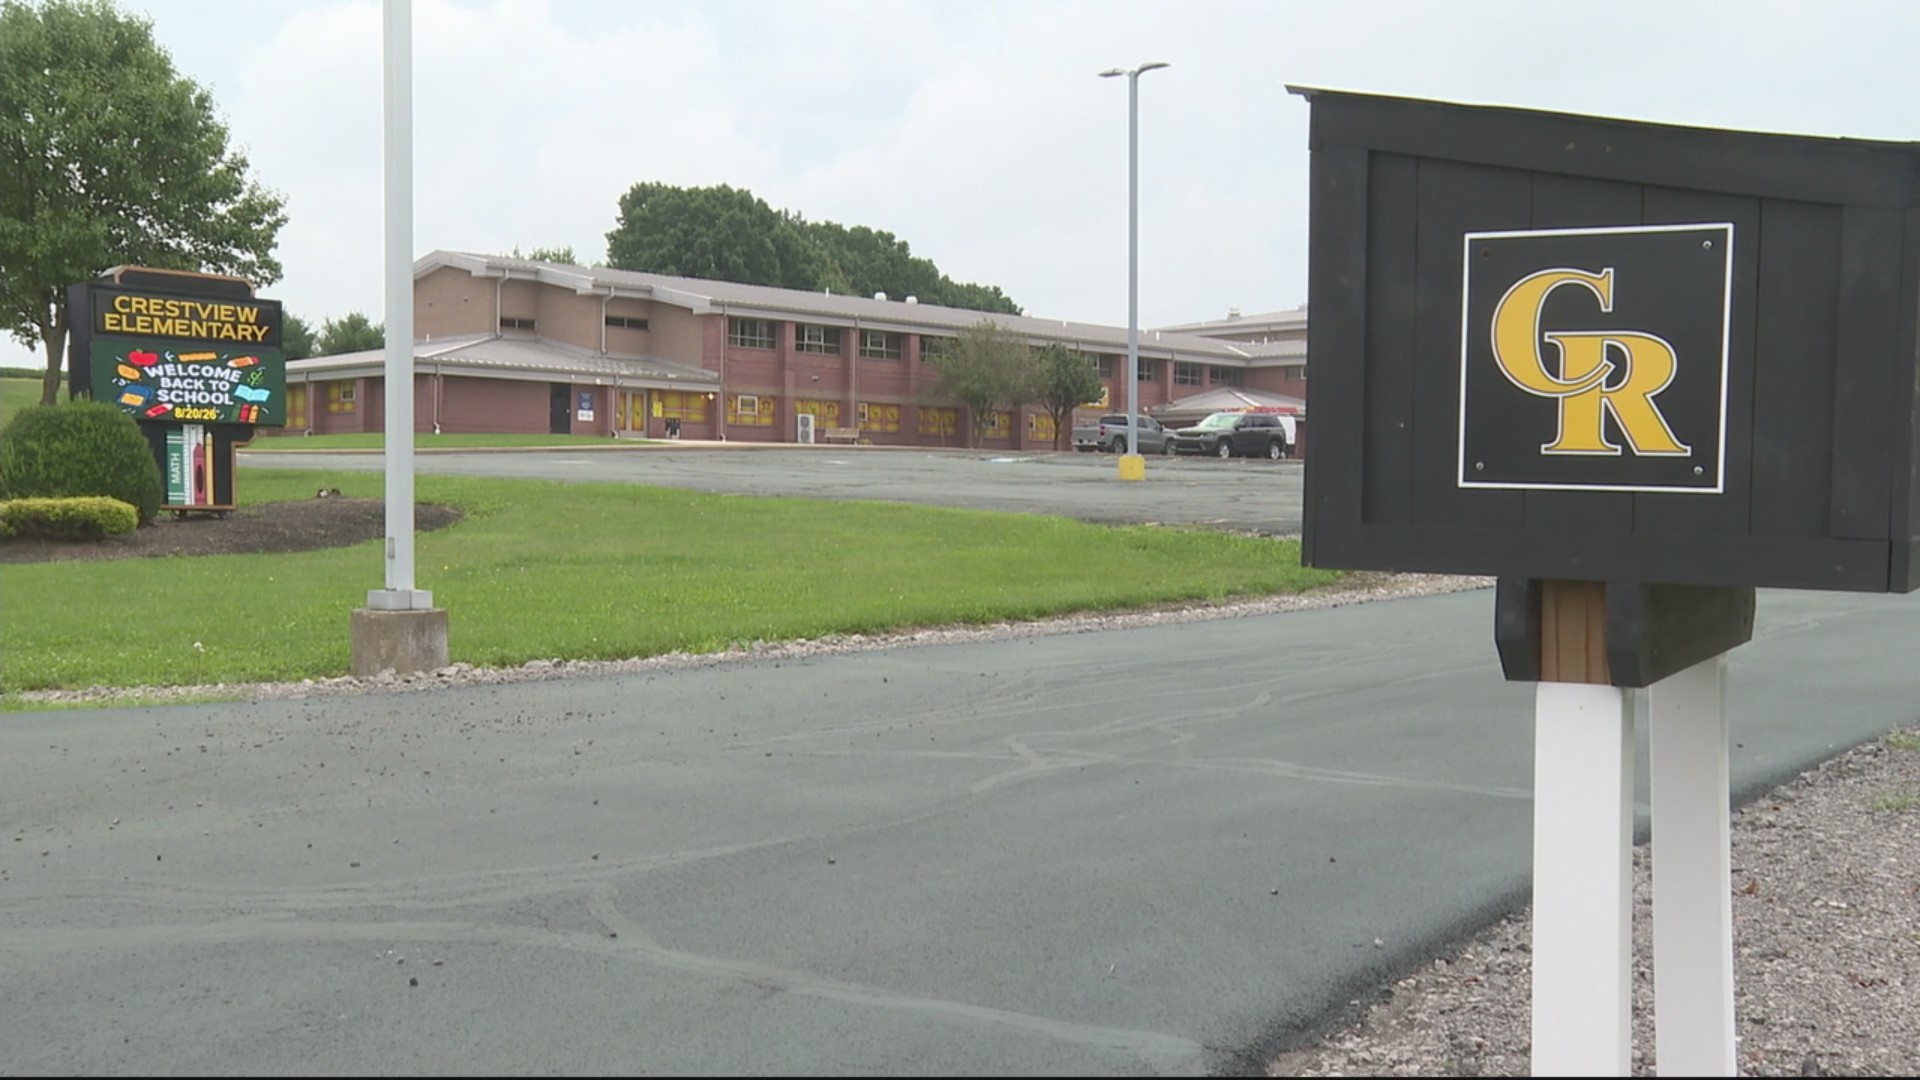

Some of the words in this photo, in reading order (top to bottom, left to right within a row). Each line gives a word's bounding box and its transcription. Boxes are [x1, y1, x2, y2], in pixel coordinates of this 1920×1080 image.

[114, 296, 258, 323] CRESTVIEW
[104, 314, 269, 342] ELEMENTARY
[143, 364, 242, 383] WELCOME
[160, 378, 205, 390] BACK
[209, 380, 230, 391] TO
[157, 389, 234, 405] SCHOOL
[171, 453, 180, 484] MATH
